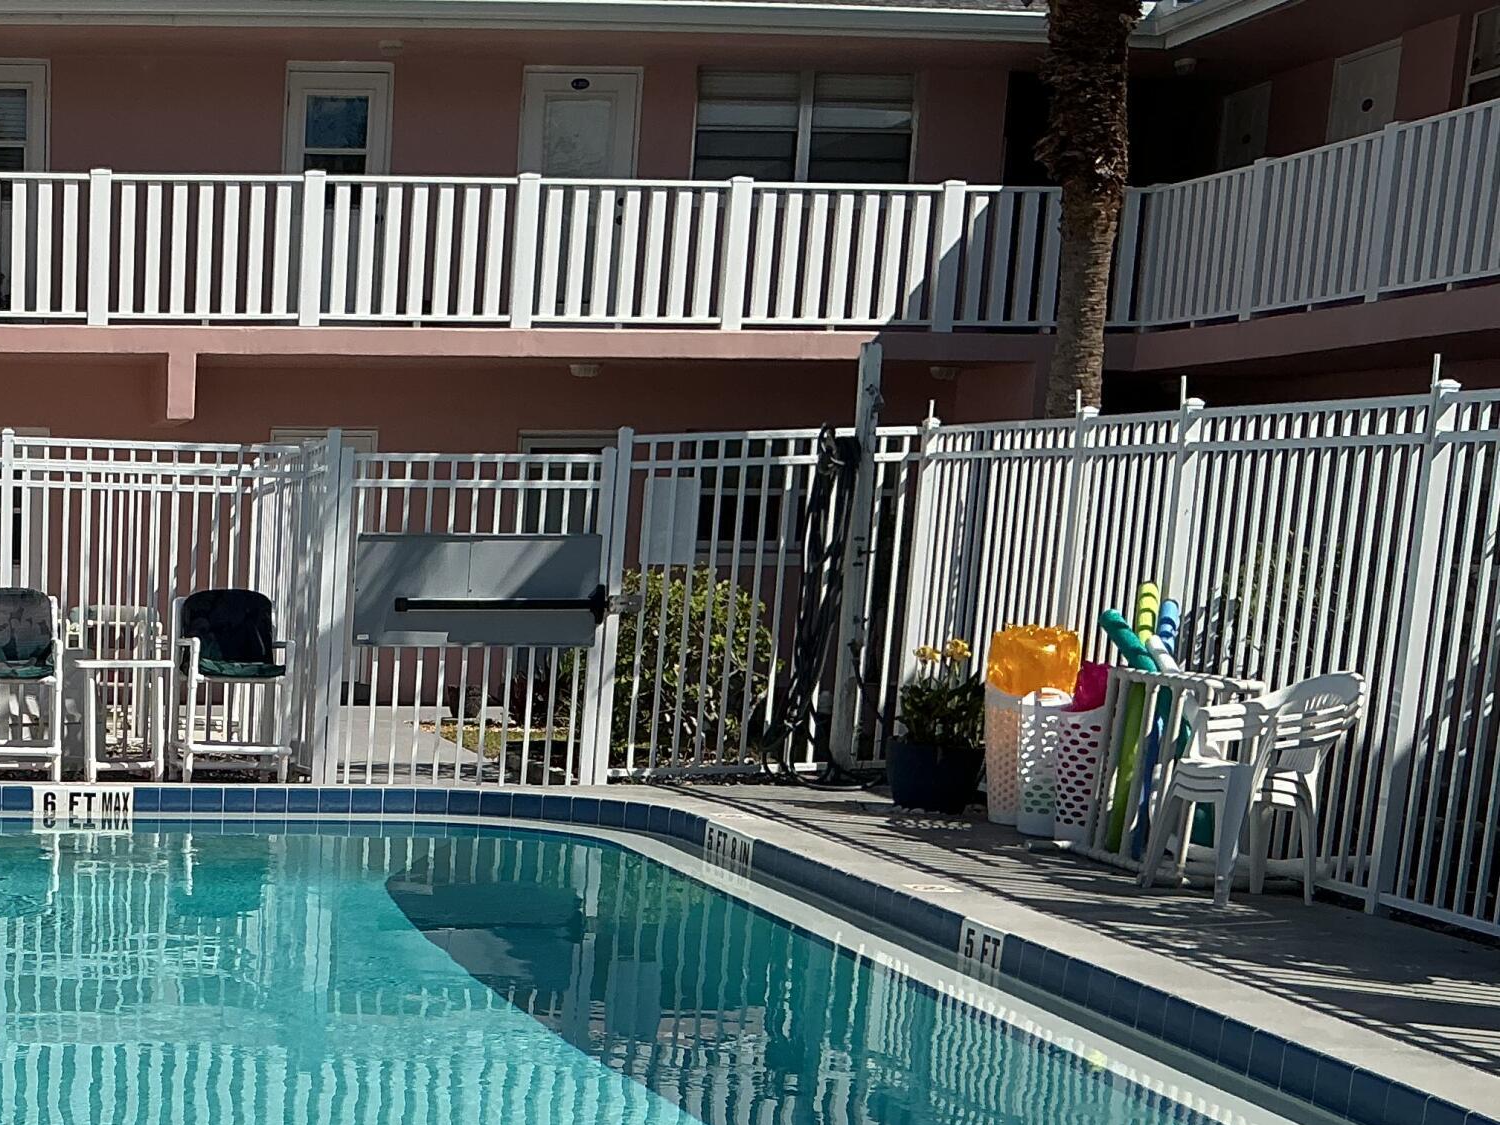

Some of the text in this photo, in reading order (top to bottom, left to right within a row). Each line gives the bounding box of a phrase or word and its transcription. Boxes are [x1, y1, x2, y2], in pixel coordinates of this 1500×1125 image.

[43, 792, 130, 811] 6 FT MAX
[708, 827, 750, 866] 5 FT 8 IN
[965, 928, 1000, 968] 5 FT
